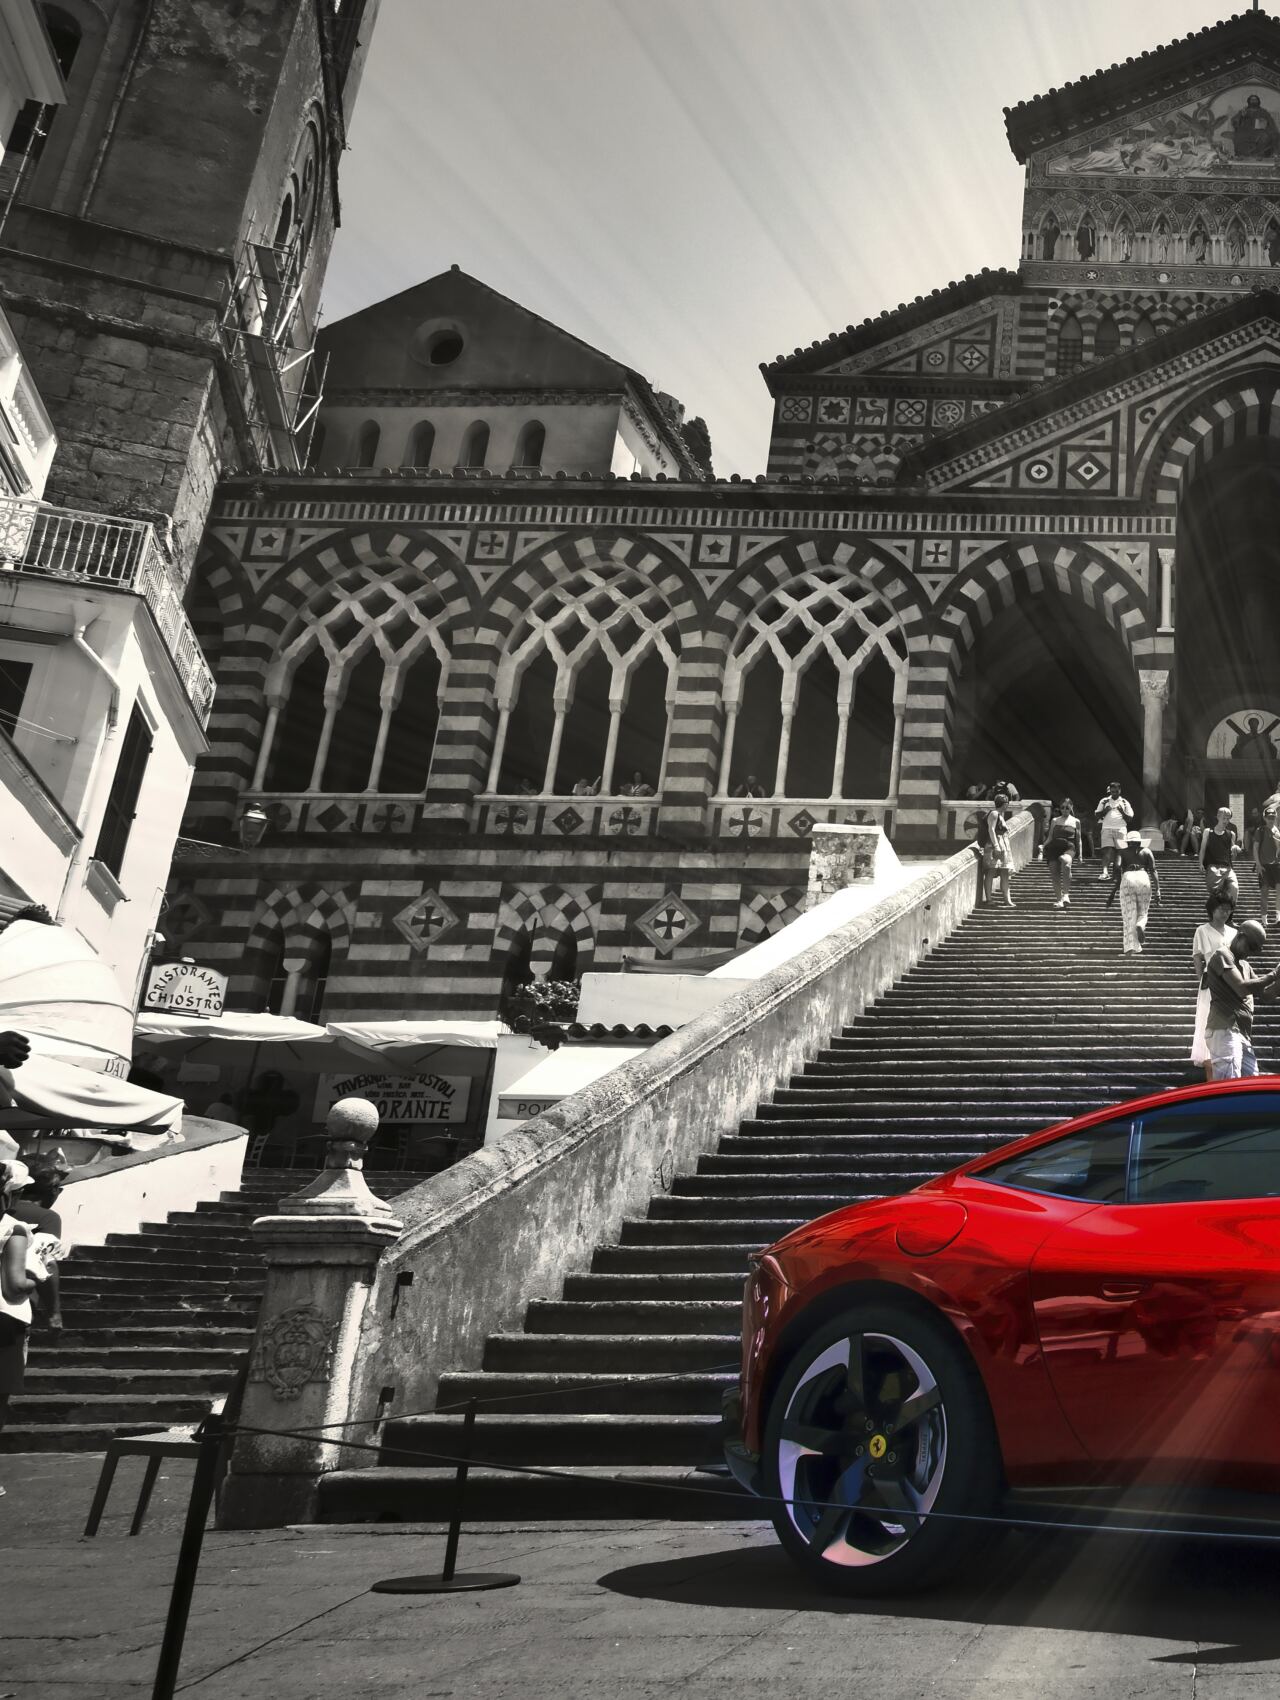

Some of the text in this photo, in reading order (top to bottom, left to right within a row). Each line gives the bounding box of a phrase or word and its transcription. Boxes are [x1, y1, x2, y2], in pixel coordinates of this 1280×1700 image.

[154, 966, 220, 998] RISTORANTE
[184, 985, 193, 993] IL
[147, 991, 222, 1011] CHIOSTRO
